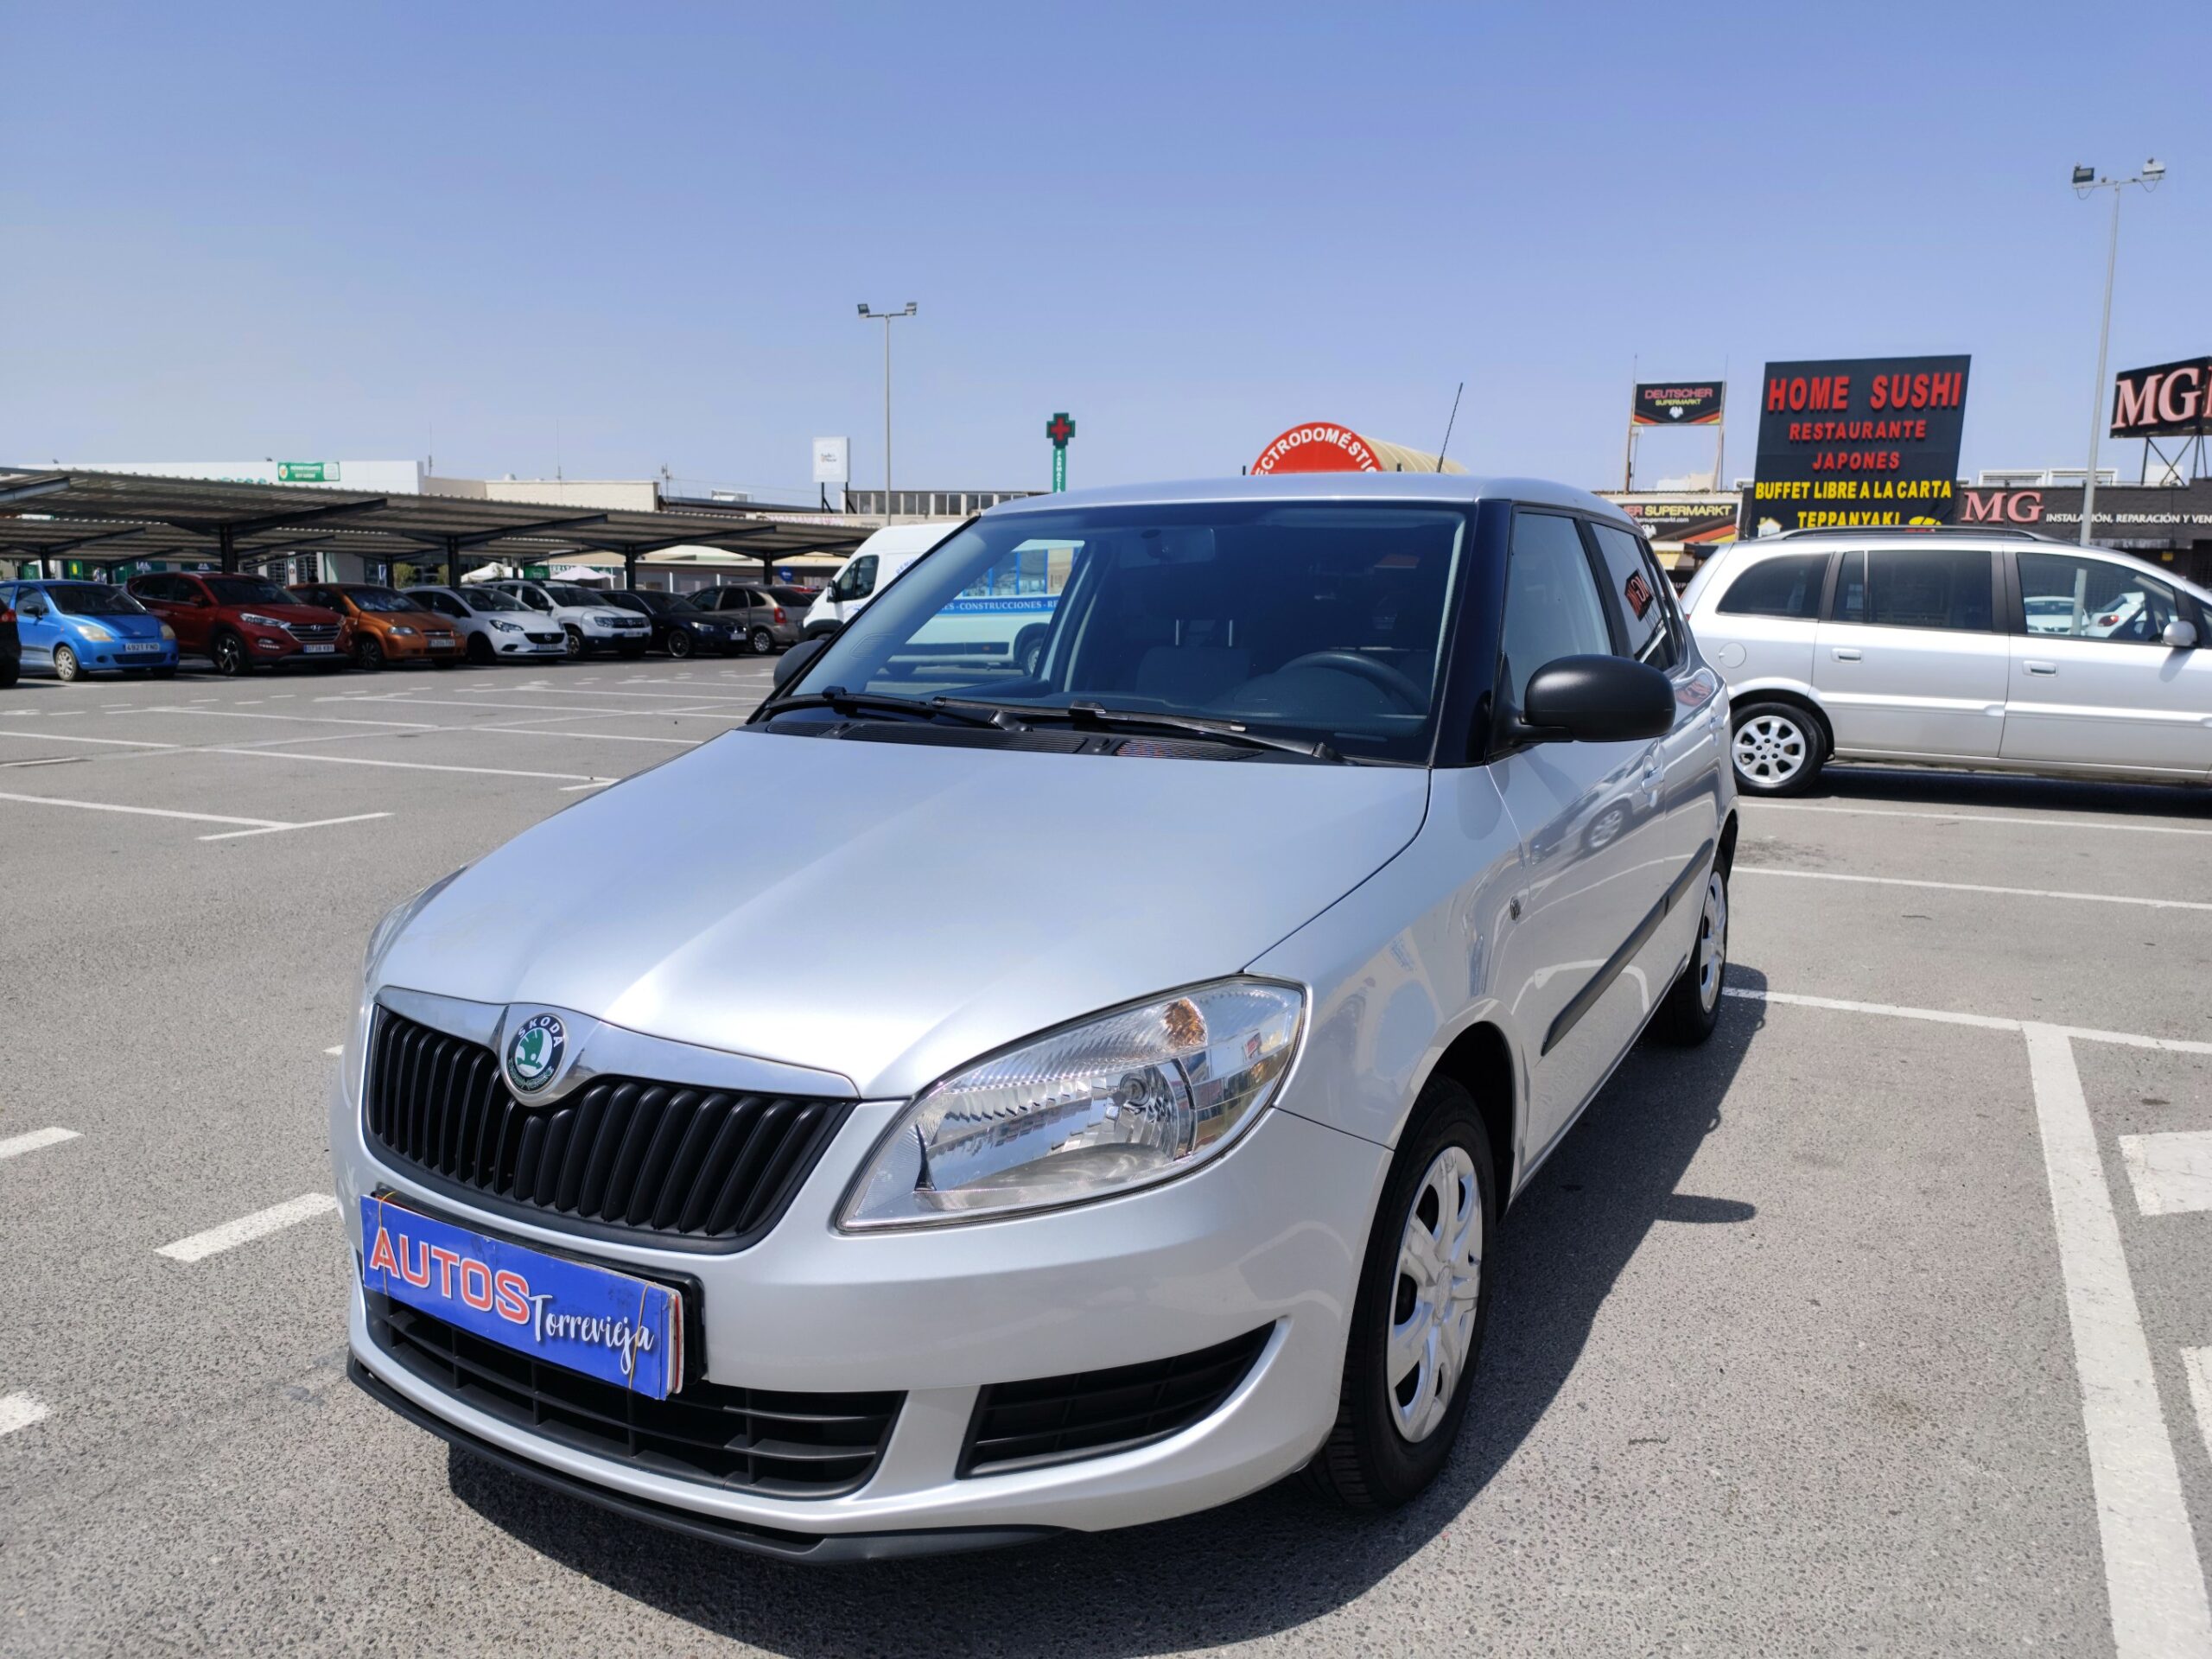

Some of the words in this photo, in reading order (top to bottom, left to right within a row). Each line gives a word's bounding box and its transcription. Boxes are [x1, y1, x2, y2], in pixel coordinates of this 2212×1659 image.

[1644, 388, 1713, 399] DEUTSCHER
[1767, 376, 1850, 411] HOME
[1870, 372, 1962, 409] SUSHI
[1789, 420, 1927, 441] RESTAURANTE
[1812, 451, 1900, 470] JAPONES
[1755, 481, 1811, 499] BUFFET
[1814, 481, 1857, 499] LIBRE
[1859, 481, 1870, 499] A
[1873, 480, 1893, 499] LA
[1897, 480, 1952, 499] CARTA
[1644, 505, 1732, 516] SUPERMARKT
[1961, 491, 2044, 524] MG
[1797, 511, 1901, 529] TEPPANYAKI
[2046, 512, 2113, 524] INSTALAIÓN,
[2116, 512, 2180, 524] REPARACIÓN
[2183, 514, 2192, 523] Y
[960, 600, 1041, 610] CONSTRUCCIONES
[370, 1227, 531, 1325] AUTOS
[529, 1294, 654, 1375] Torrevieja
